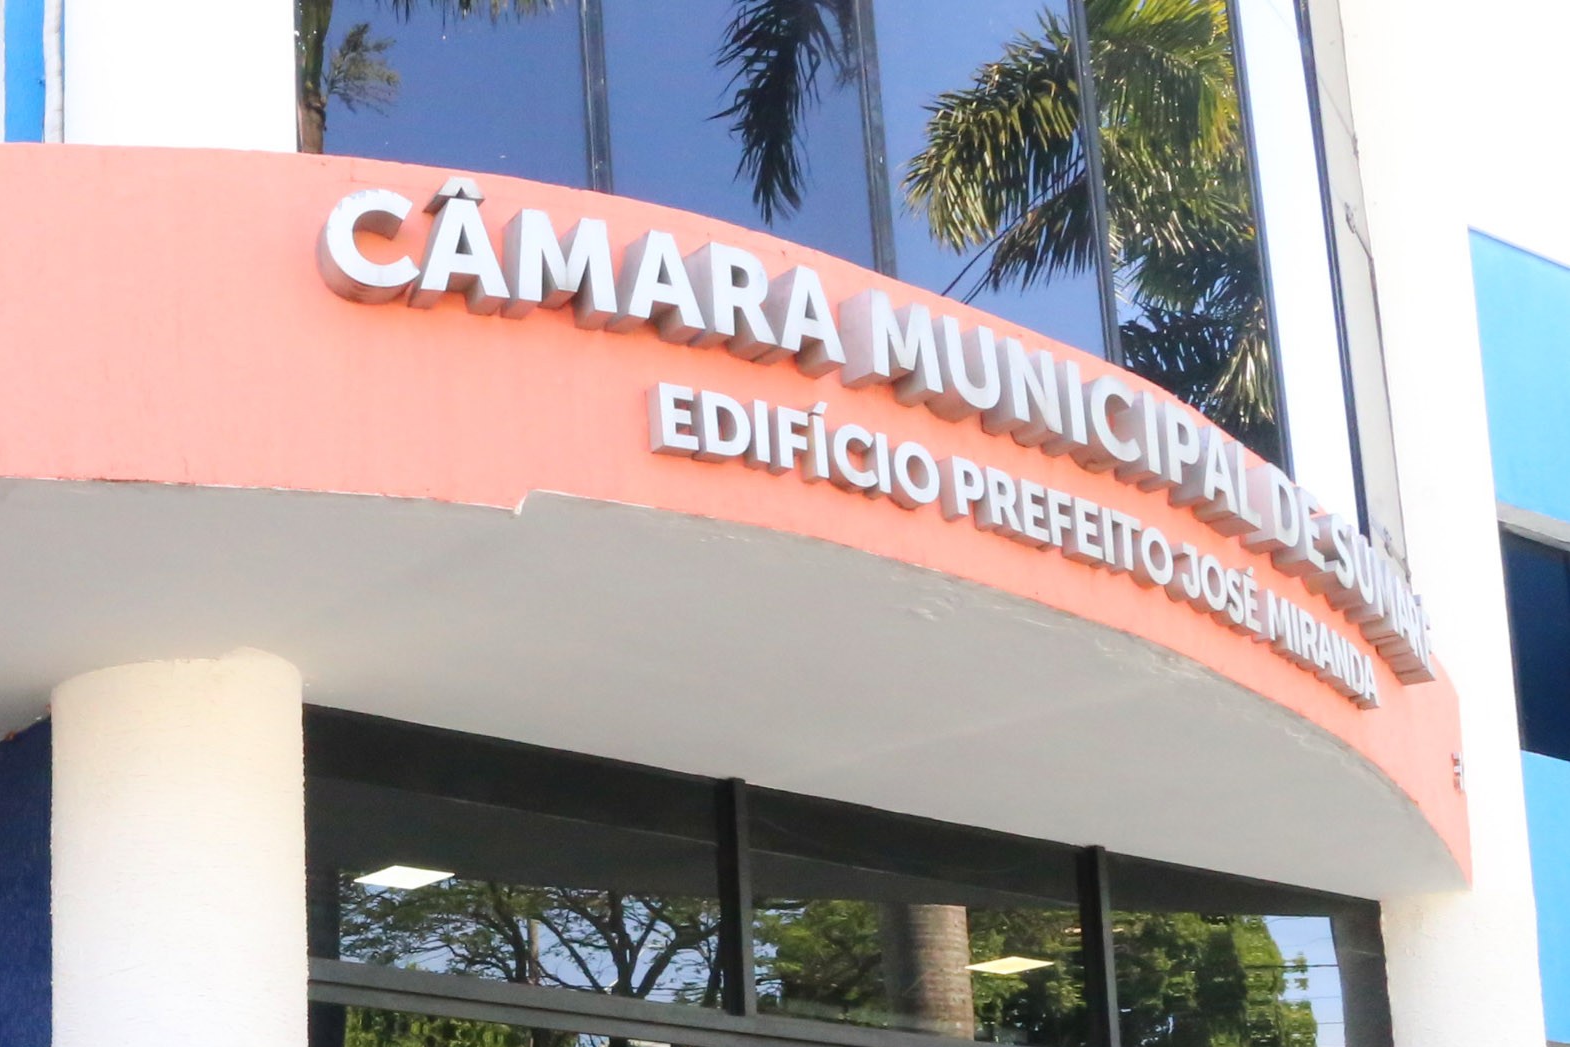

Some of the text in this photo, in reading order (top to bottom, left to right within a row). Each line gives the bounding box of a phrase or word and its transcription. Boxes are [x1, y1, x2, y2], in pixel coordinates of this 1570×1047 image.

[318, 177, 846, 378] CÂMARA
[841, 288, 1261, 537] MUNICIPAL
[1250, 463, 1326, 575] DE
[646, 382, 1380, 709] EDIFÍCIO PREFEITO JOSÉ MIRANDA
